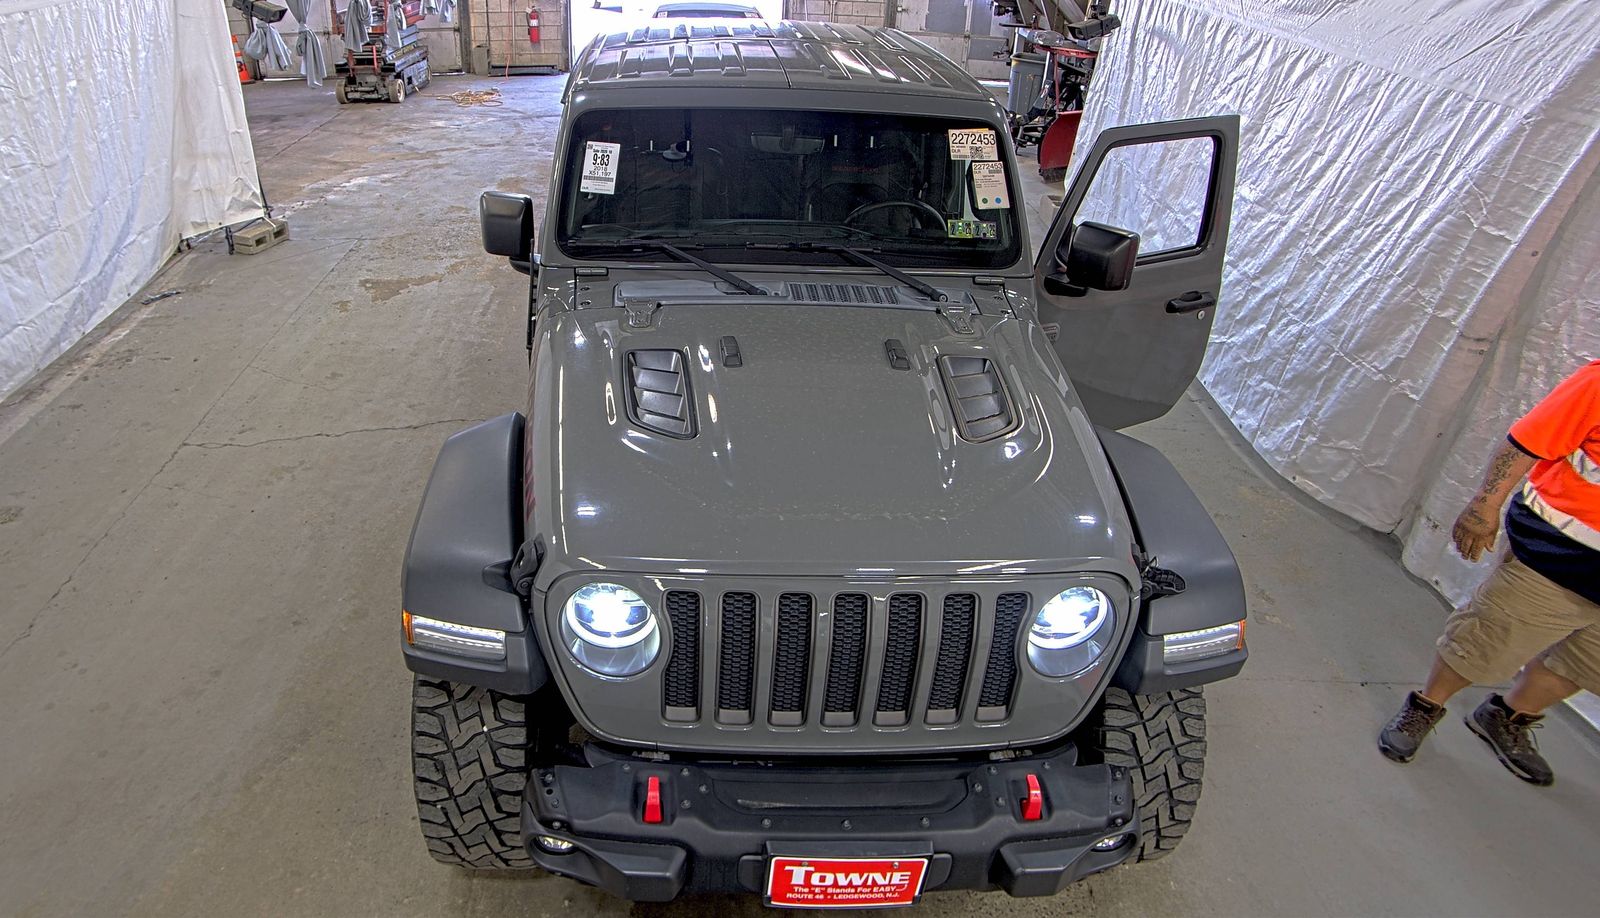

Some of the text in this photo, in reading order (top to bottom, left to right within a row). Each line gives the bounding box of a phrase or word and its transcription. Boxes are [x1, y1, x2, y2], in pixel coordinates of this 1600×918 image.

[951, 132, 996, 146] 2272453
[592, 153, 610, 166] 9:83
[784, 866, 912, 886] TOWNE
